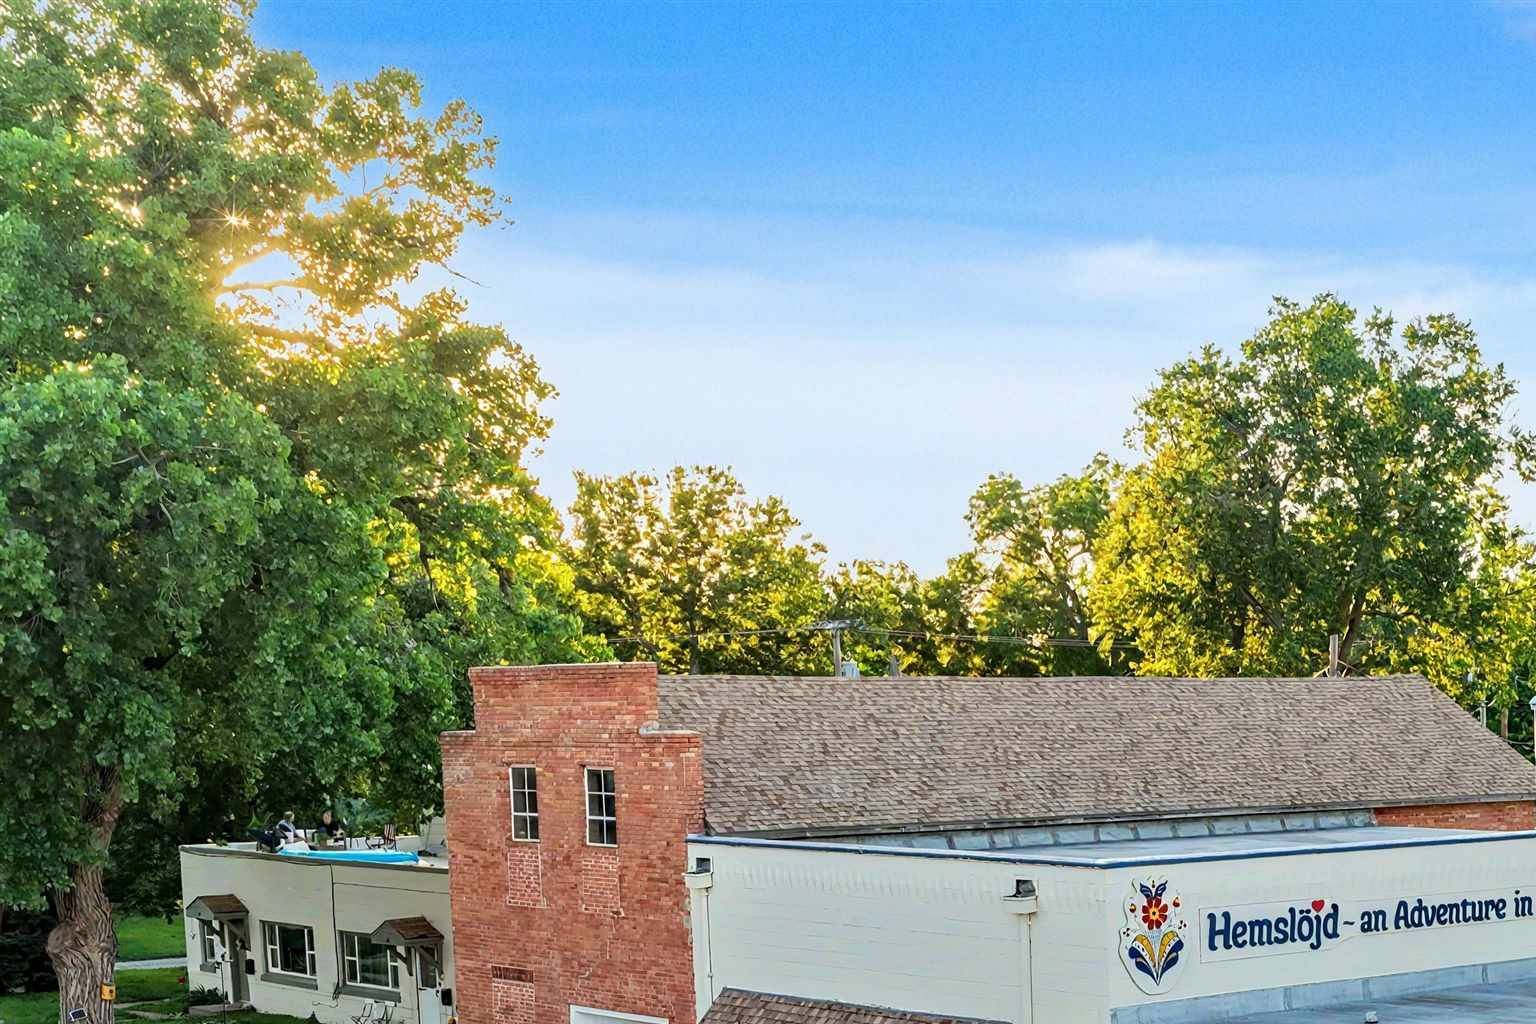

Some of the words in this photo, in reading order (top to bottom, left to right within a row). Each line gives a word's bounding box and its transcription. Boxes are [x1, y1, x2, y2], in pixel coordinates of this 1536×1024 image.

[1207, 901, 1340, 951] Hemslöjd
[1360, 909, 1388, 933] an
[1394, 898, 1506, 930] Adventure
[1514, 890, 1534, 917] in
